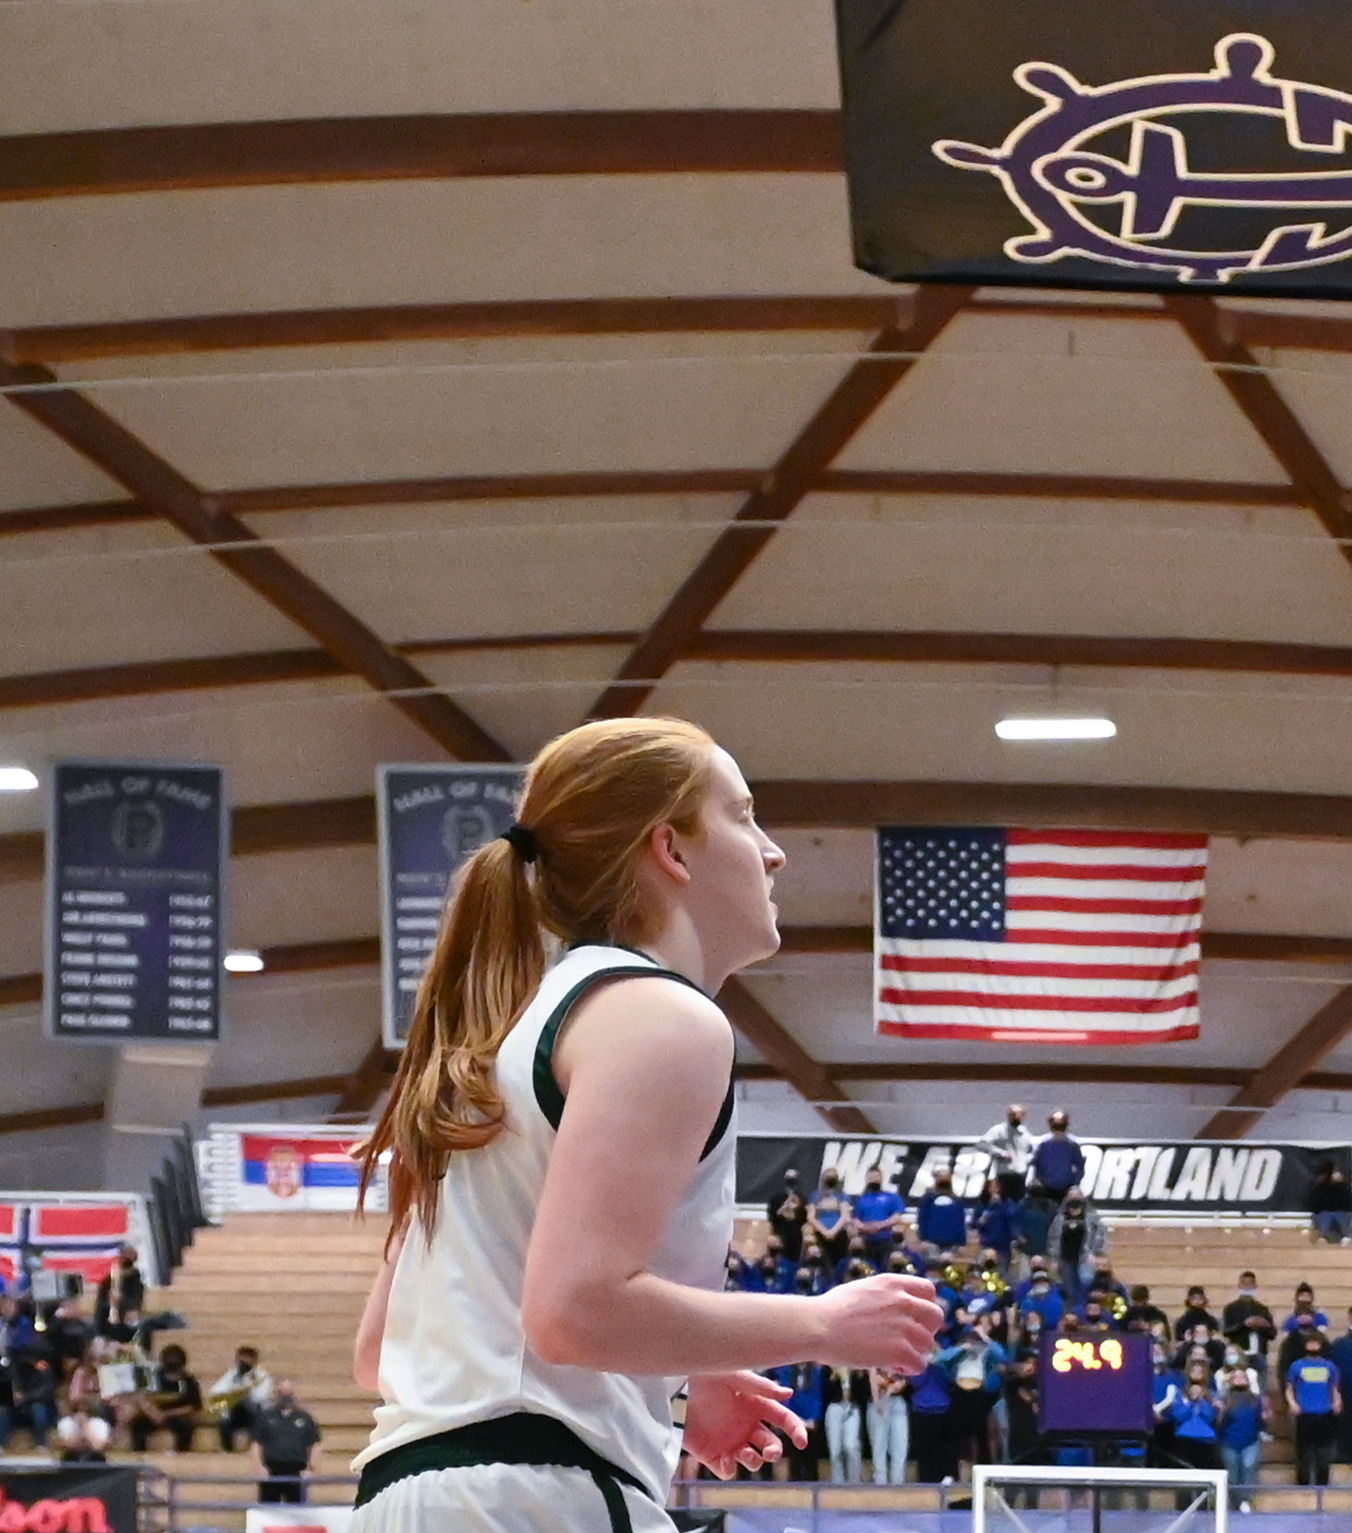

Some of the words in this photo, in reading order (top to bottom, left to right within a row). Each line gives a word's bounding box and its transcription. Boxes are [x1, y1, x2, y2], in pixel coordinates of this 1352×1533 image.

[819, 1141, 909, 1197] WE
[908, 1145, 997, 1198] AR
[1027, 1145, 1284, 1201] ORTLAND
[1052, 1339, 1123, 1373] 24.9
